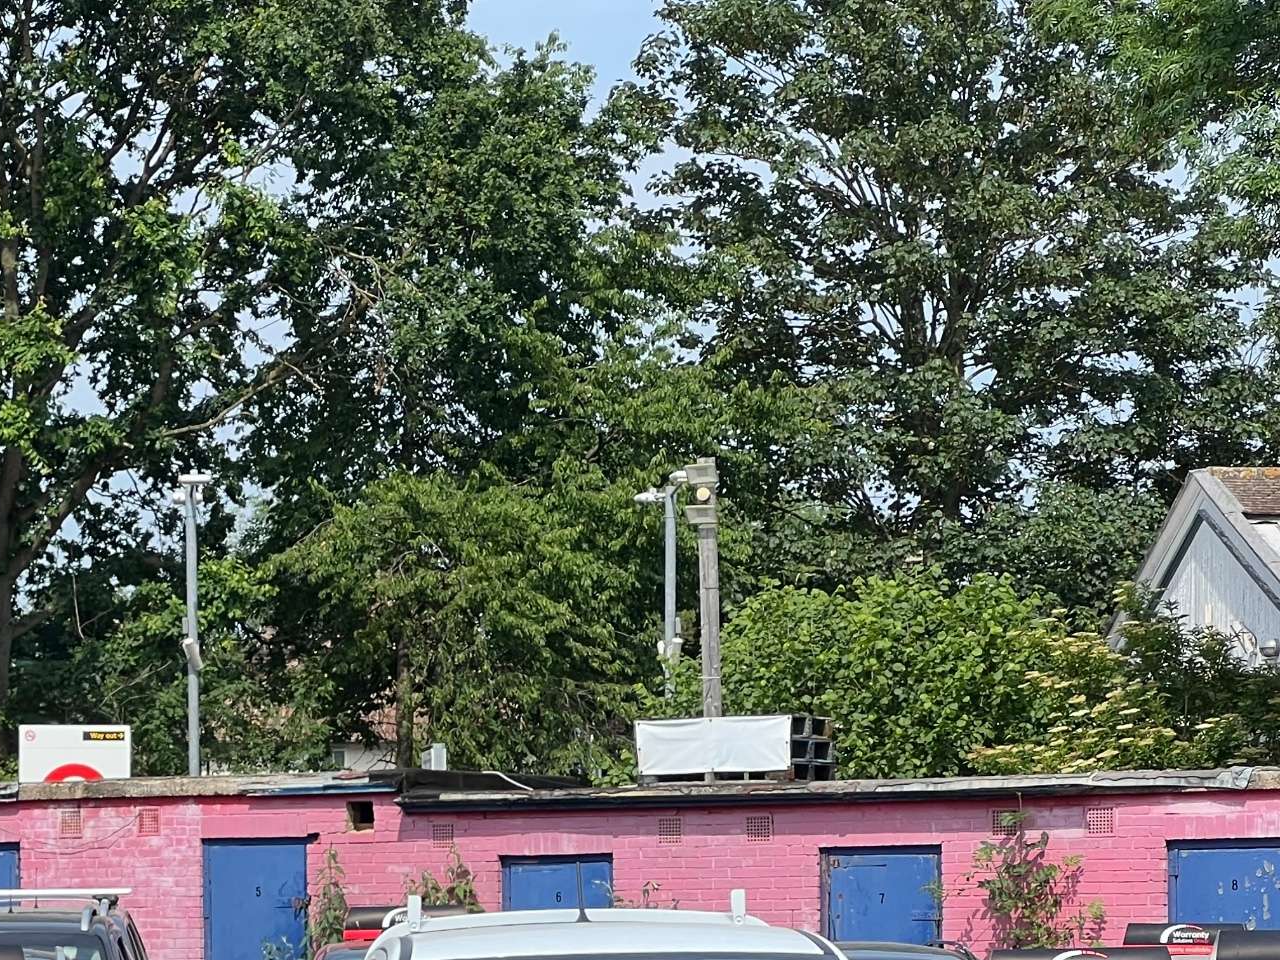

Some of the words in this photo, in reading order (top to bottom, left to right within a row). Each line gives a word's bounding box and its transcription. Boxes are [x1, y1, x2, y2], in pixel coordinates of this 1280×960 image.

[89, 732, 104, 741] Way
[105, 732, 117, 740] out
[1231, 879, 1238, 891] 8
[255, 886, 262, 897] 5
[555, 891, 562, 903] 6
[879, 892, 885, 905] 7
[1173, 931, 1209, 939] Warranty
